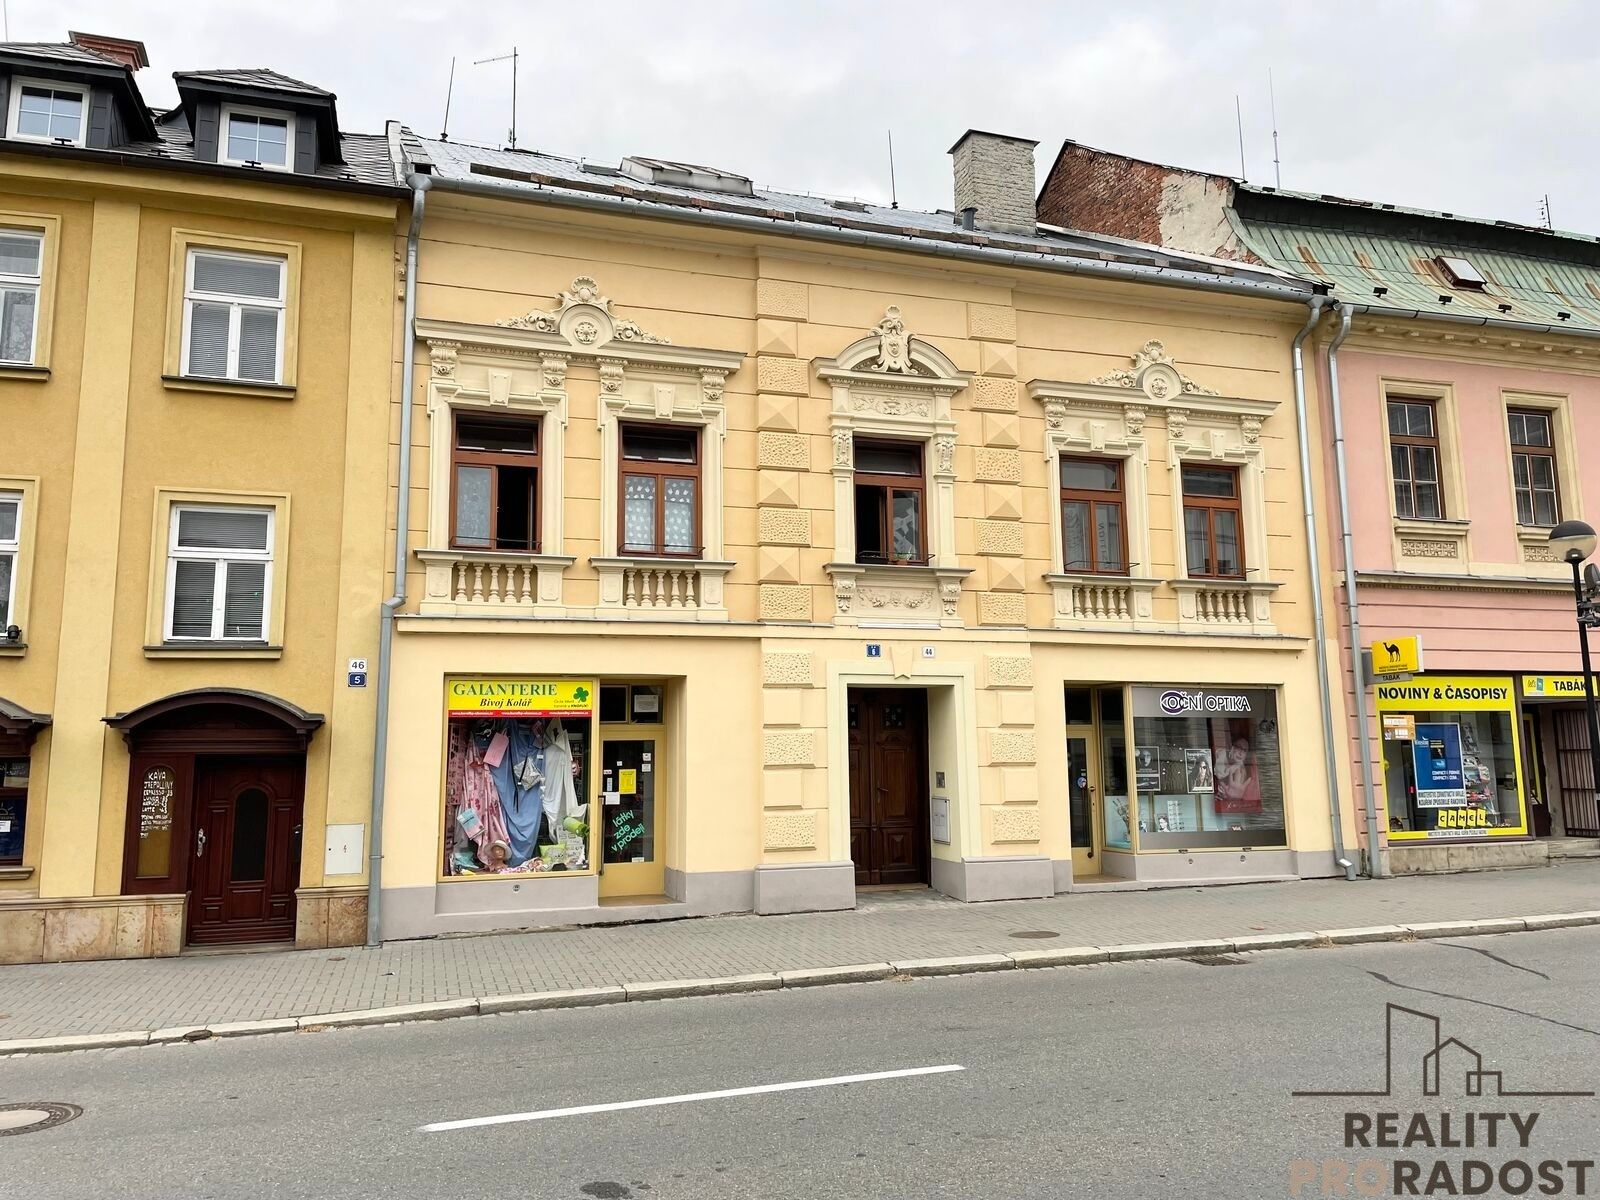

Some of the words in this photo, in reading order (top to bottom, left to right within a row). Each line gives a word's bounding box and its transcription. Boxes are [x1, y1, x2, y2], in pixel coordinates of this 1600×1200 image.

[351, 661, 365, 670] 46
[354, 675, 361, 684] 5
[453, 683, 558, 696] GALANTERIE
[1378, 687, 1430, 699] NOVINY
[1433, 687, 1442, 699] &
[1444, 684, 1508, 700] ČASOPISY
[479, 698, 504, 709] Bivoj
[506, 697, 532, 707] Kolář
[1165, 691, 1204, 712] OČNÍ
[1205, 695, 1251, 711] OPTIKA
[612, 810, 634, 827] látky
[1439, 813, 1484, 822] CAMEL
[613, 824, 631, 840] zde
